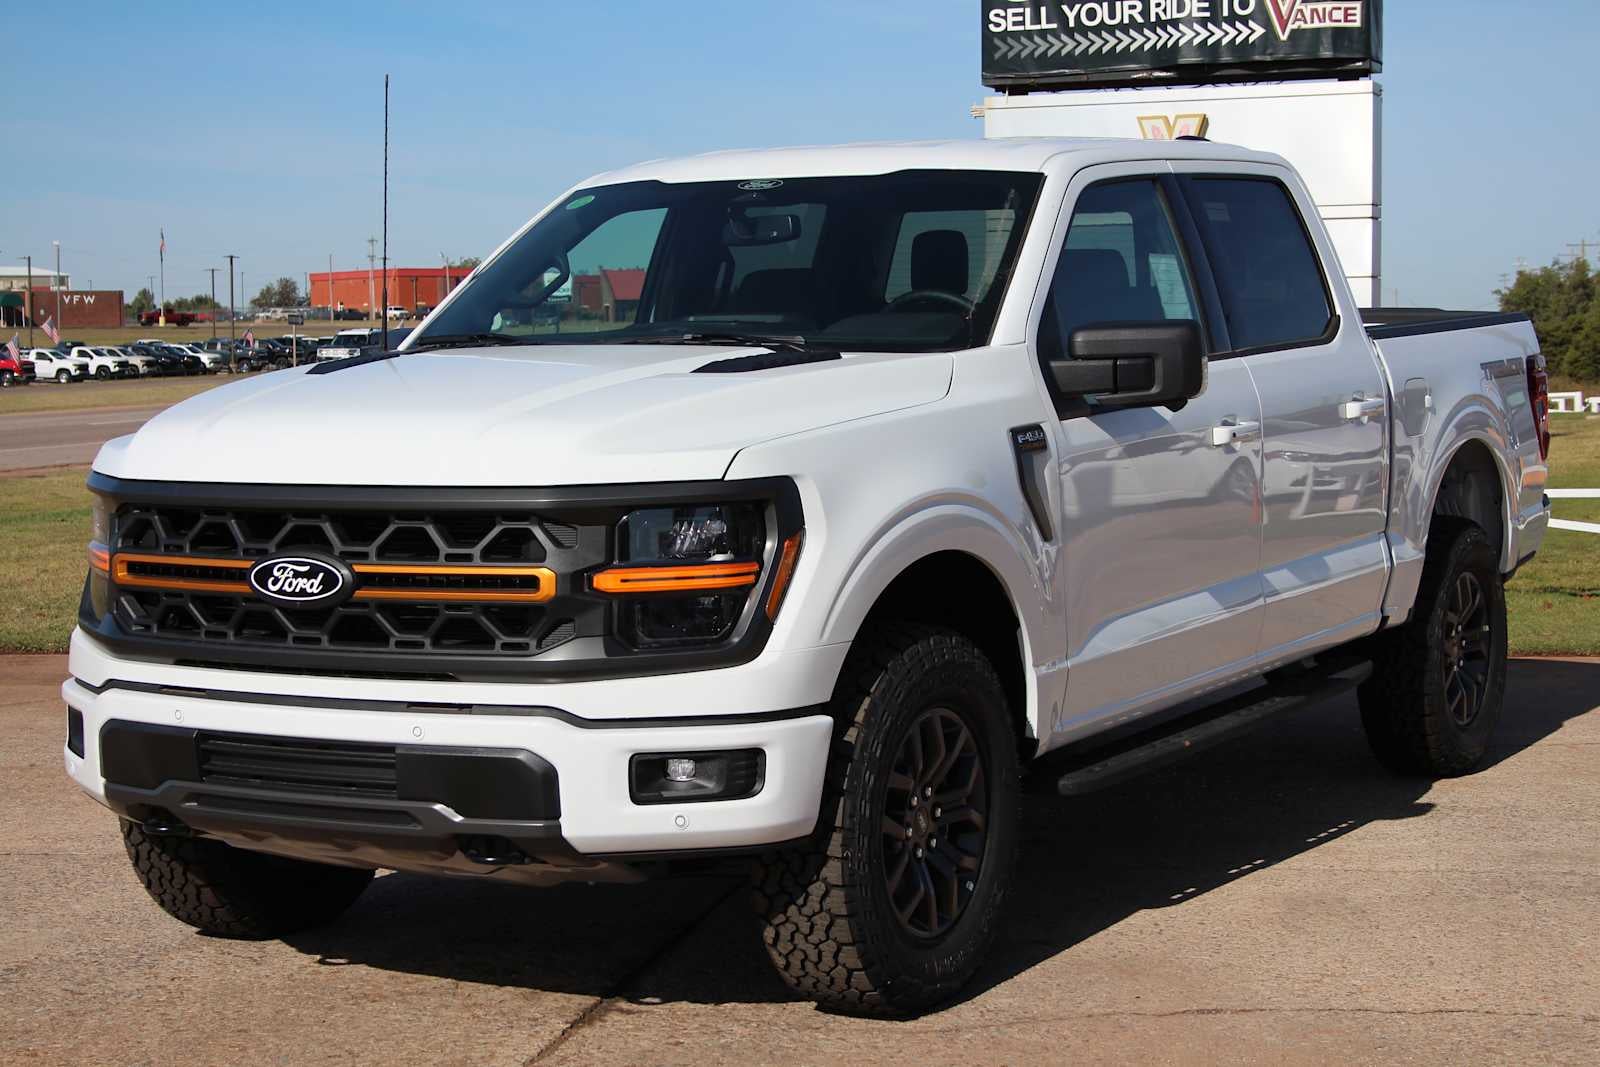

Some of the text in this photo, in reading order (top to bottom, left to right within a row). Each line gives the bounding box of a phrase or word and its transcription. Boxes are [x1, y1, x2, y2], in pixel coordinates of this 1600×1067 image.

[988, 6, 1057, 32] SELL
[1061, 1, 1144, 27] YOUR
[1150, 0, 1210, 22] RIDE
[1265, 0, 1358, 39] VANCE
[63, 294, 96, 305] VFW
[267, 563, 324, 593] Ford
